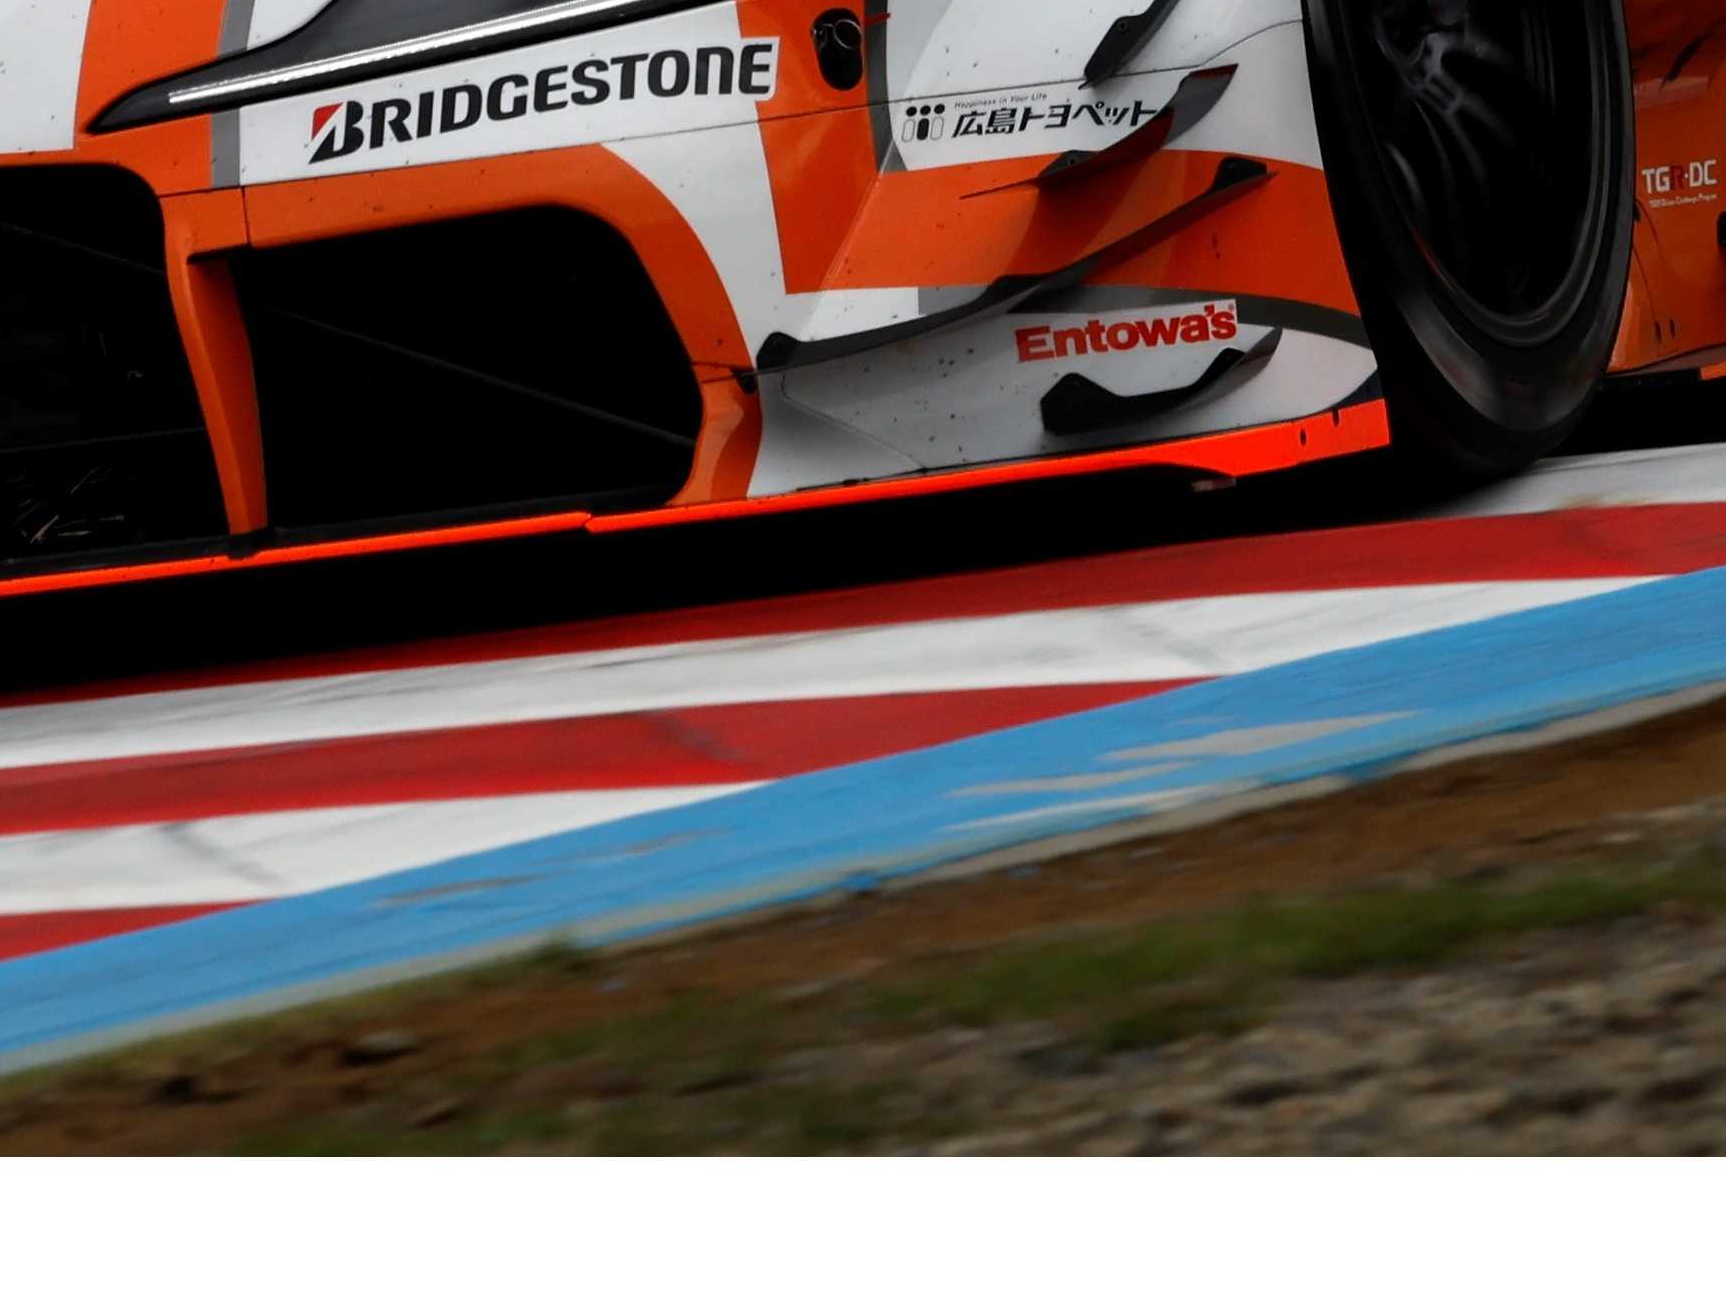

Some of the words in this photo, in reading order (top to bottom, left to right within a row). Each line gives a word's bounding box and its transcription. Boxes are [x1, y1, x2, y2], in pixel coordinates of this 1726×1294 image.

[308, 43, 773, 166] BRIDGESTONE
[951, 99, 1158, 139] 広島トヨペット
[1015, 301, 1239, 363] Entowa's
